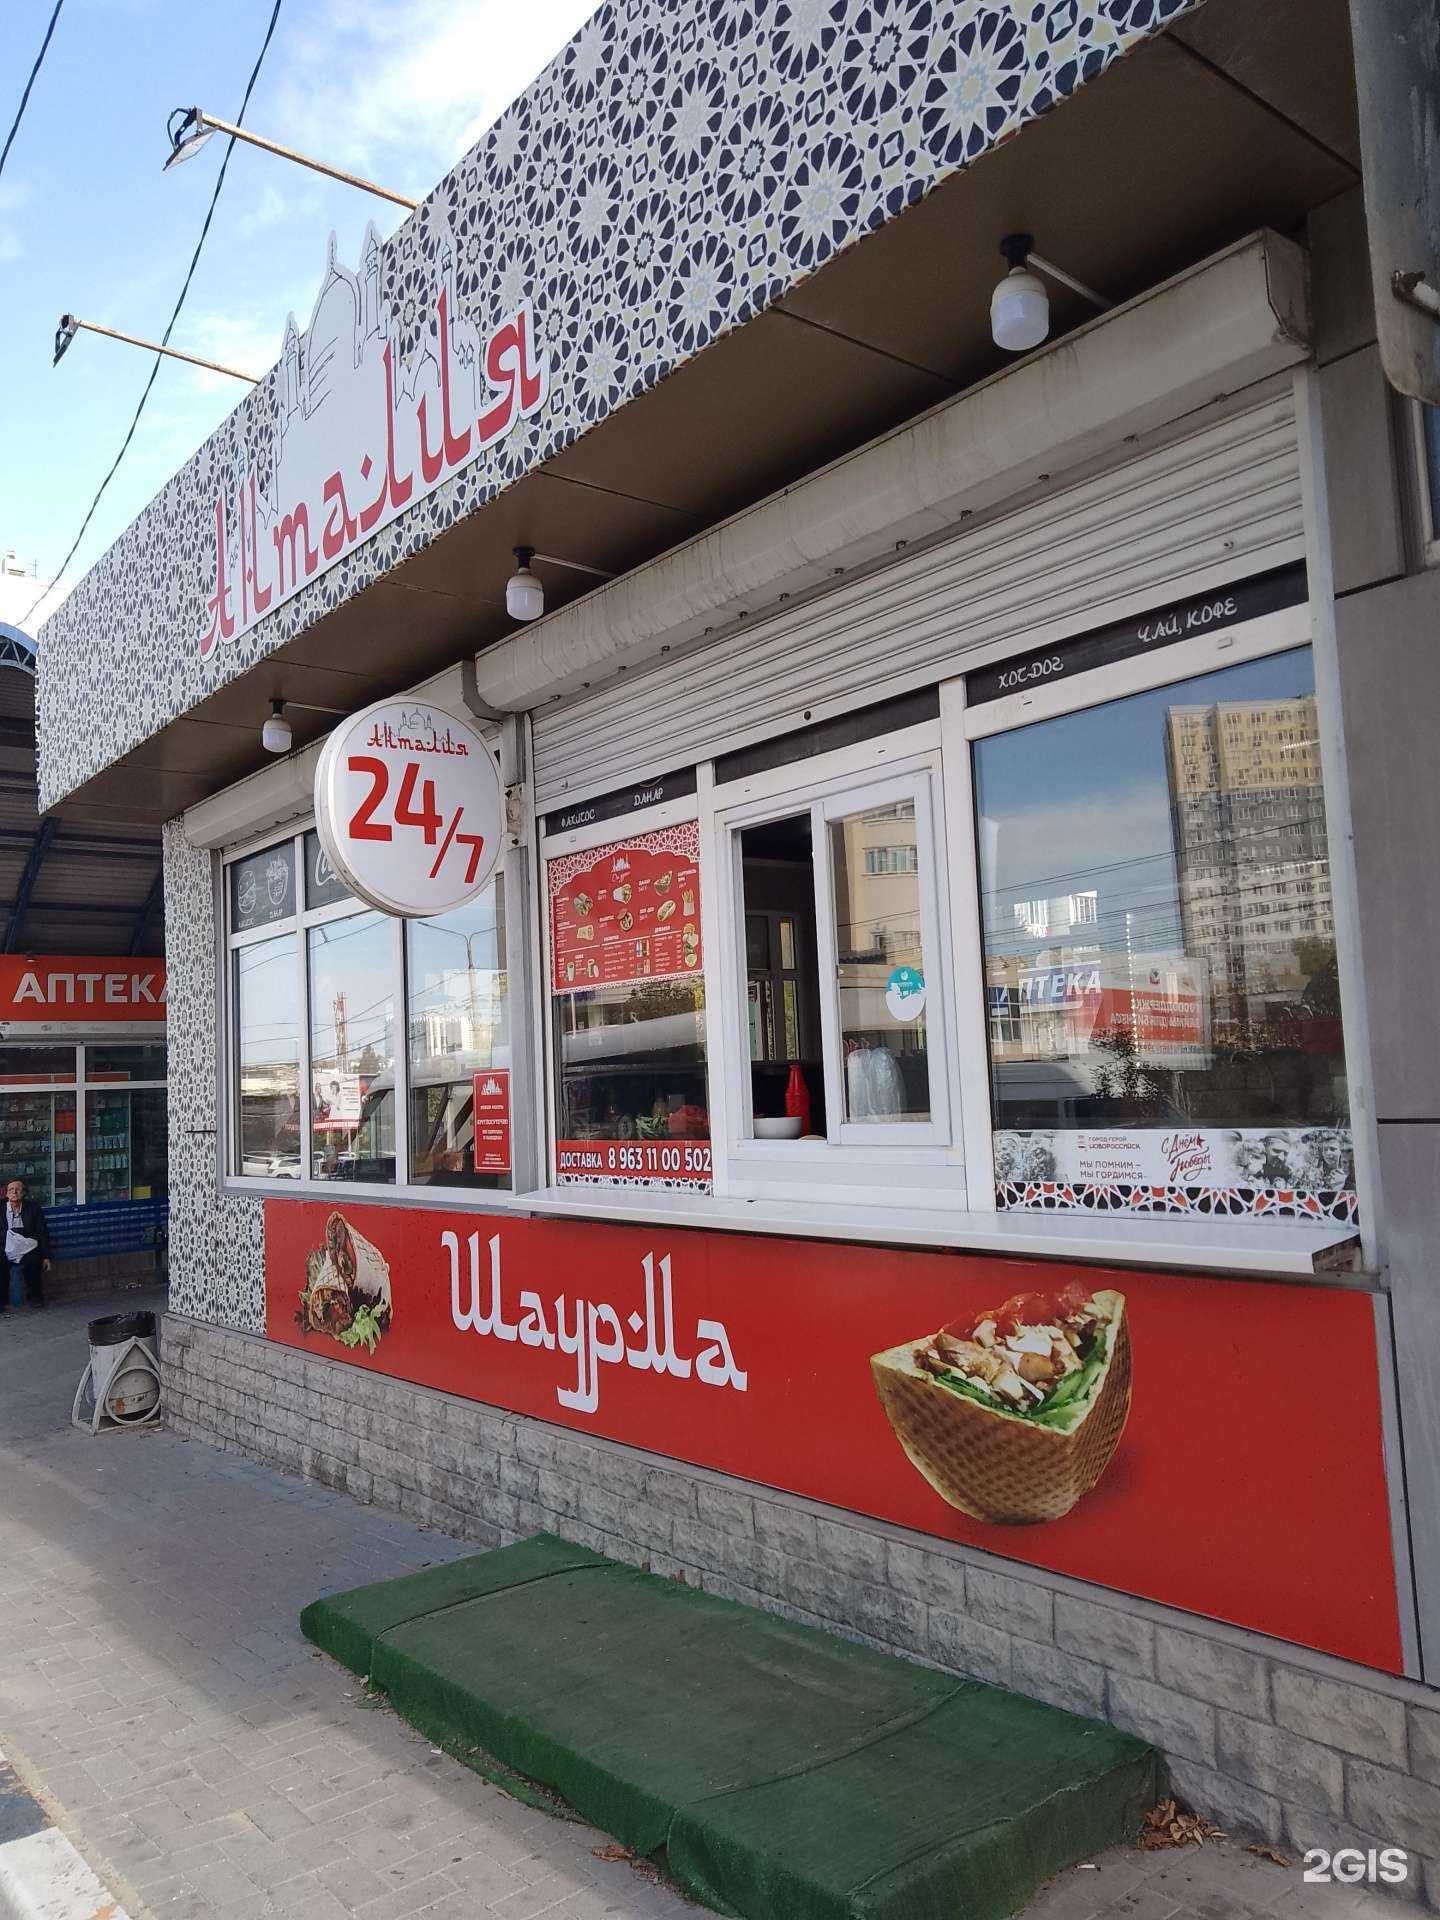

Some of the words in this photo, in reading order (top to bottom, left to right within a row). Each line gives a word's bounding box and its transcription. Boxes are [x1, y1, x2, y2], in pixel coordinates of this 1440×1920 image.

[1186, 598, 1238, 630] КОФЕ
[347, 756, 485, 884] 24/7
[560, 1151, 603, 1169] ДОСТАВКА
[608, 1146, 616, 1169] 8
[620, 1147, 643, 1170] 963
[646, 1148, 657, 1170] 11
[661, 1148, 680, 1171] 00
[684, 1148, 712, 1172] 502
[1079, 1160, 1092, 1168] МЫ
[1095, 1160, 1133, 1169] ПОМНИМ
[1080, 1170, 1093, 1178] МЫ
